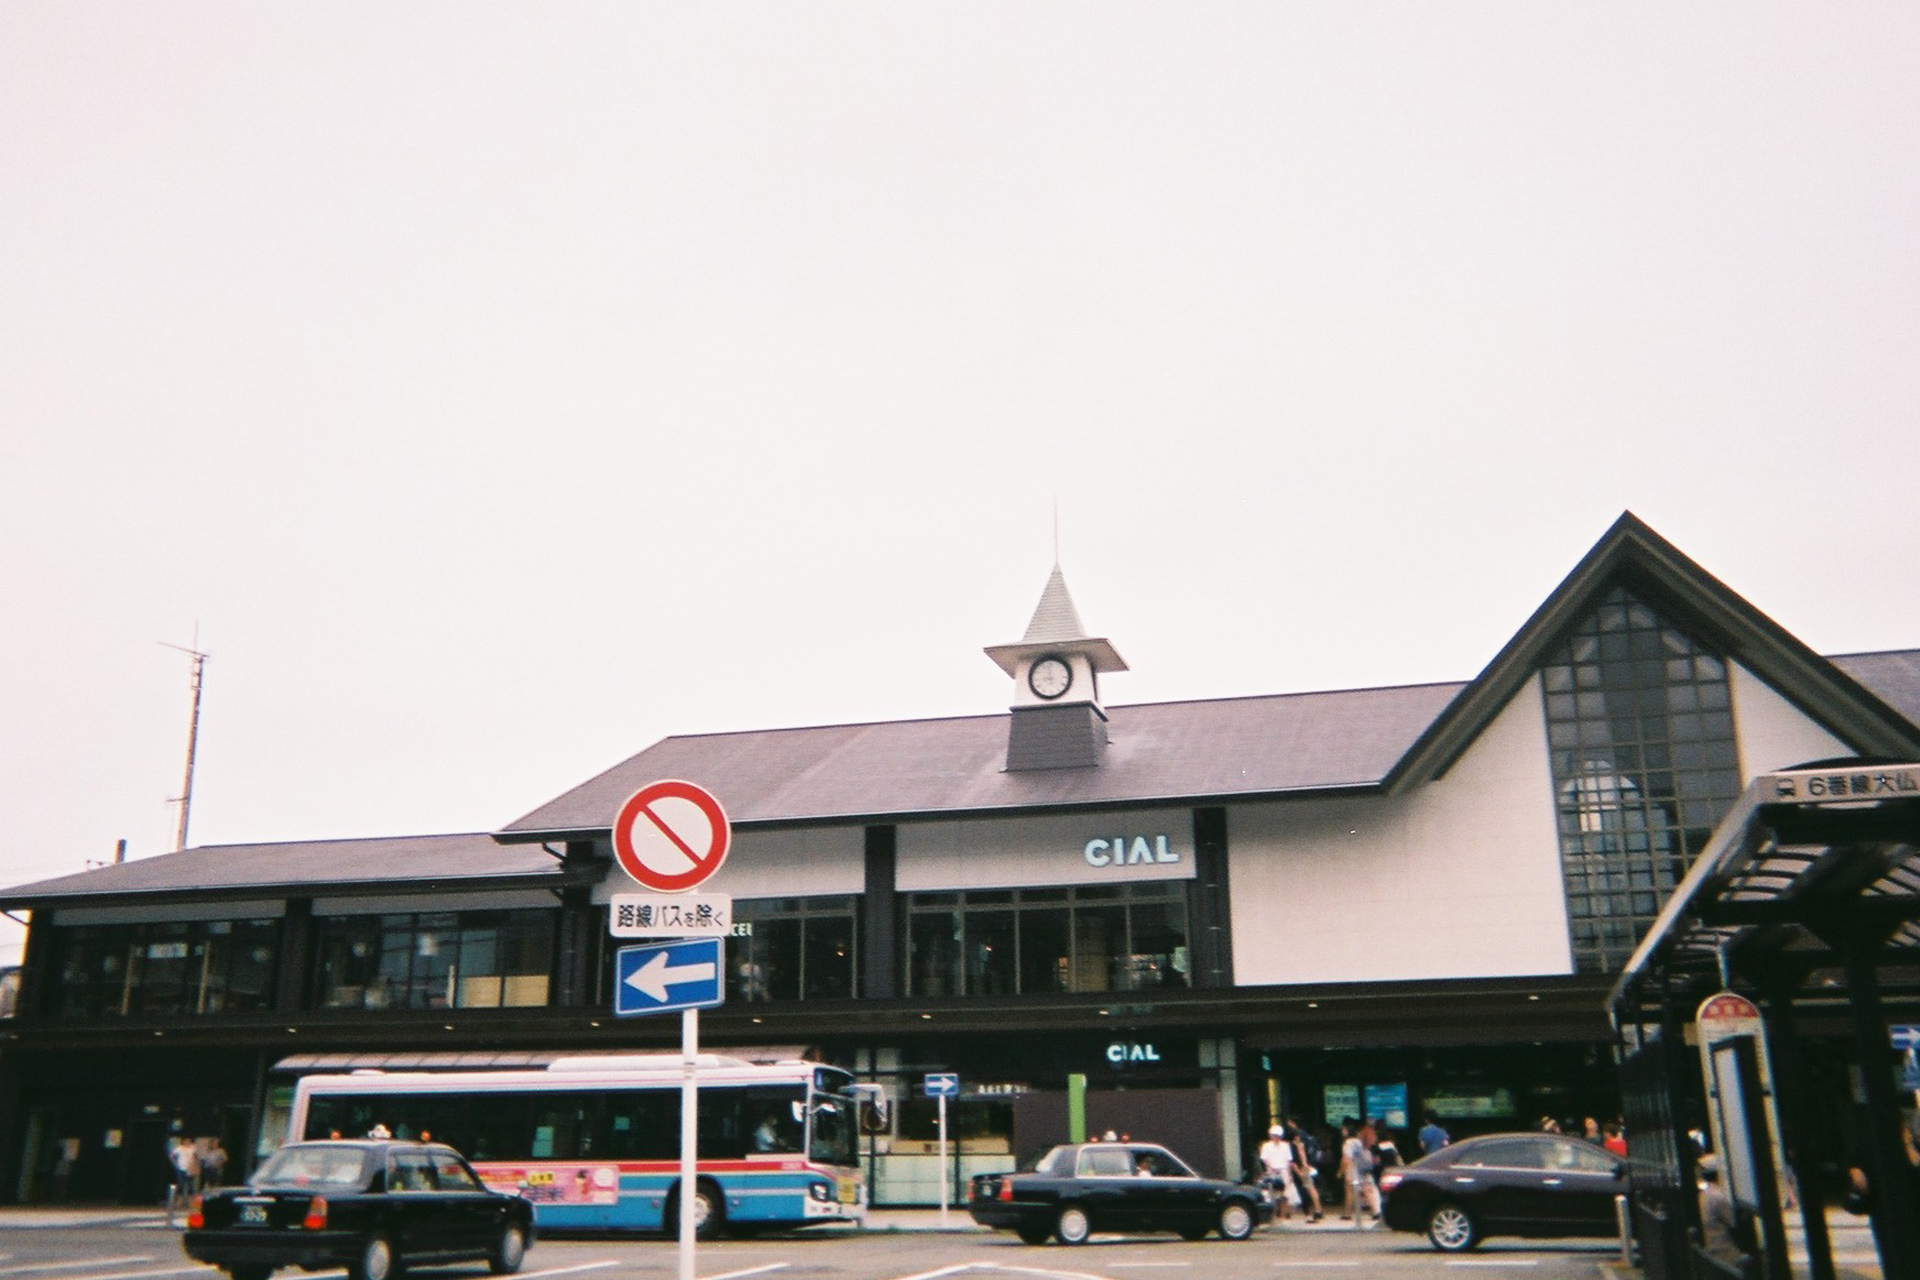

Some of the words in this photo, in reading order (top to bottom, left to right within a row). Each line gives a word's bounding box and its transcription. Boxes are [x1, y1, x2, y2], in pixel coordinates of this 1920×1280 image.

[1085, 835, 1179, 867] CIAL
[618, 904, 723, 928] 路線バスを除く
[1107, 1044, 1160, 1062] CIAL
